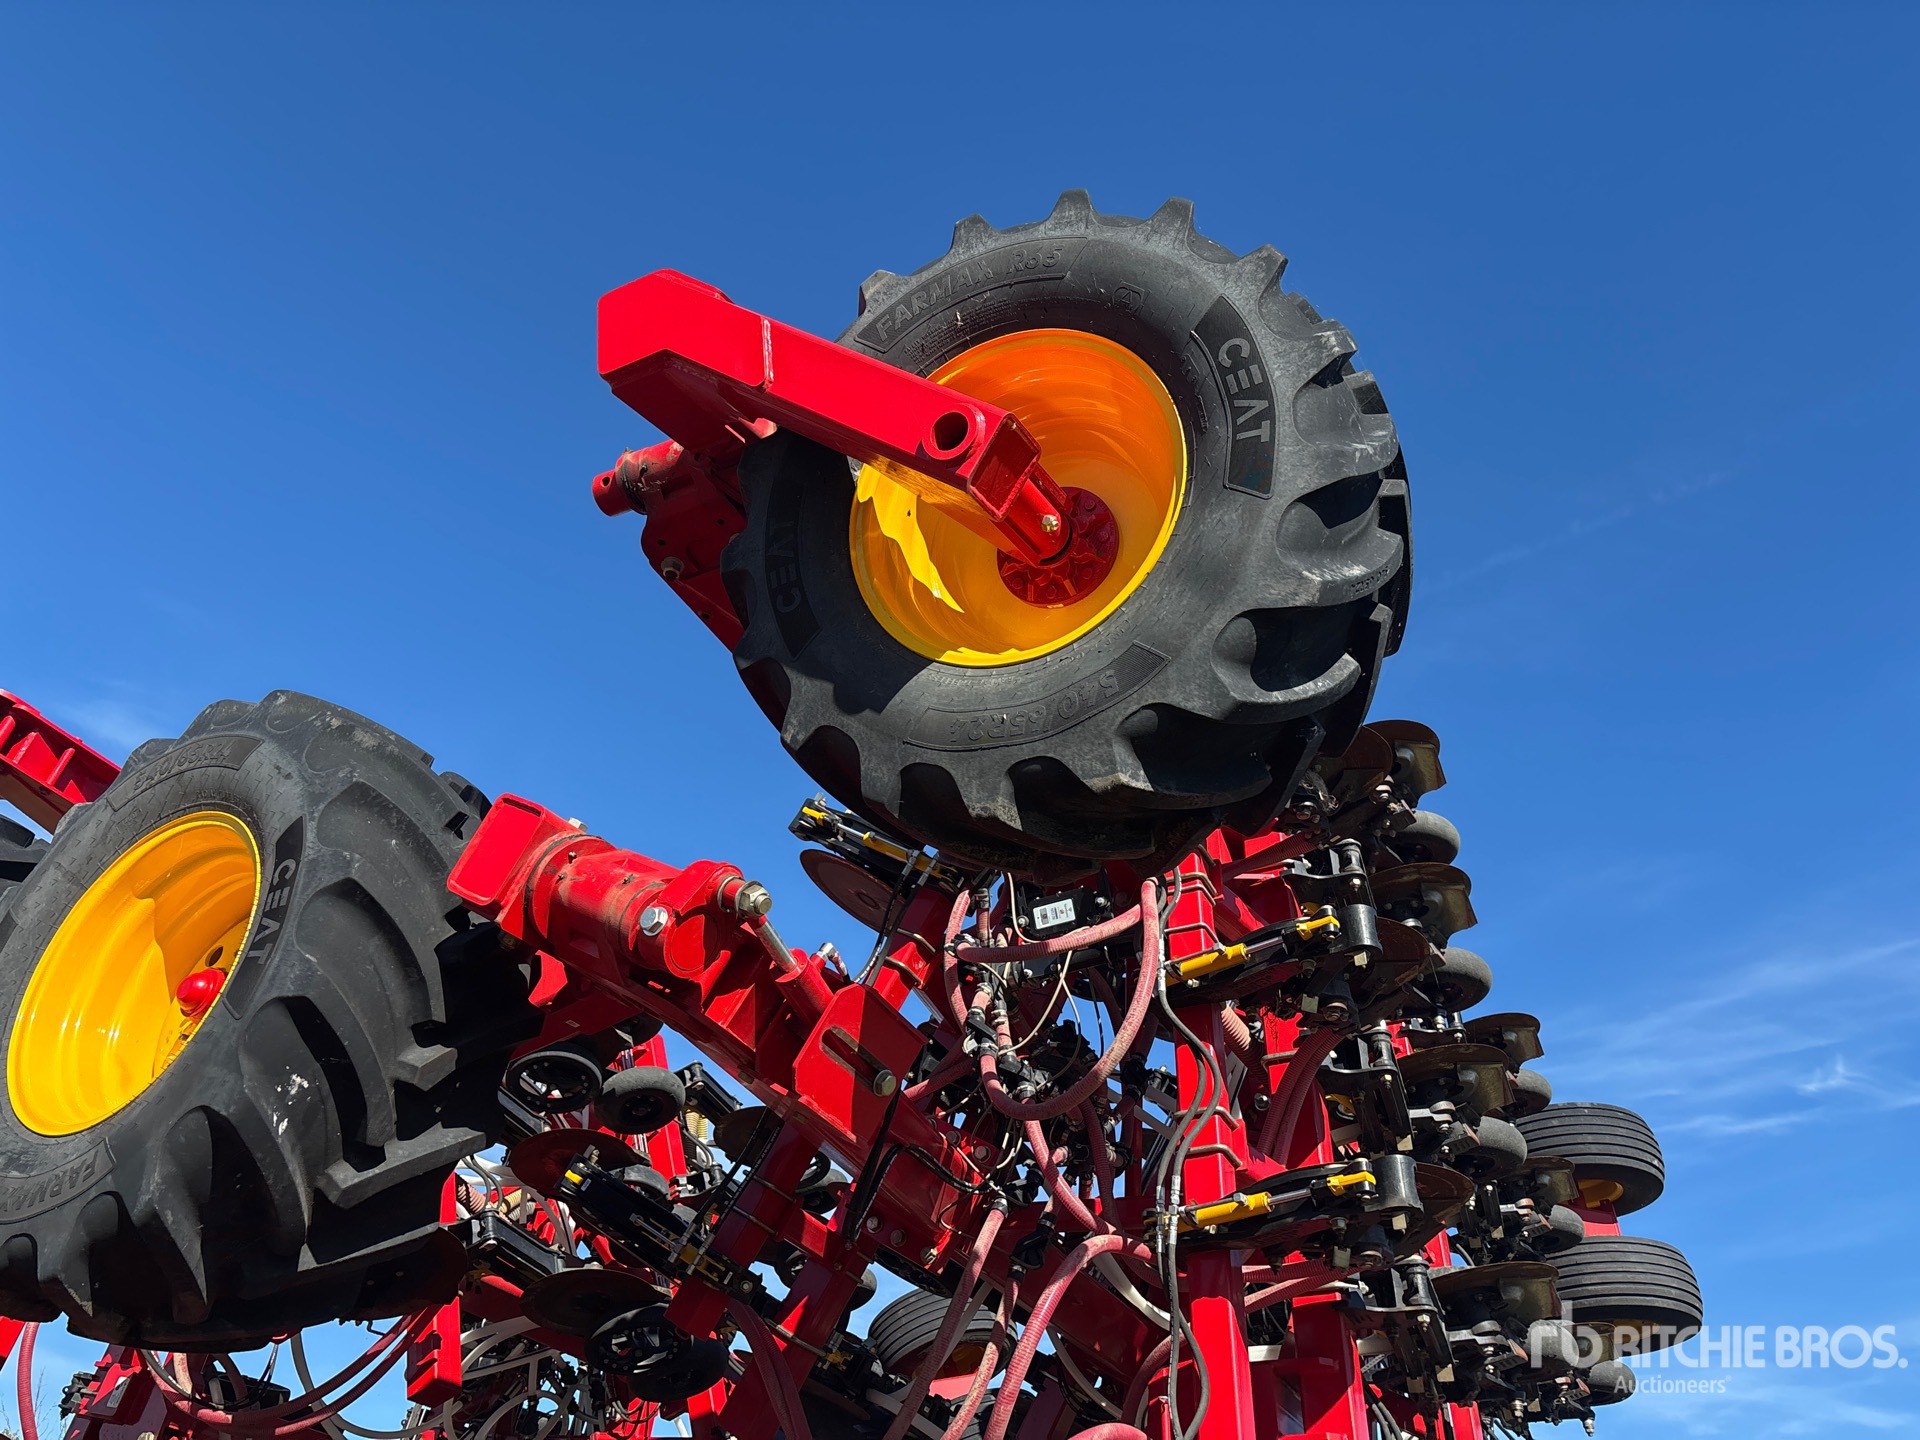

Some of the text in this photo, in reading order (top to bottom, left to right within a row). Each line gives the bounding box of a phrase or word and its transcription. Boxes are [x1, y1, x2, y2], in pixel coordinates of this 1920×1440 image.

[874, 259, 994, 342] FARMAX
[1005, 242, 1066, 276] R65
[1217, 337, 1271, 443] CEAT
[247, 858, 297, 965] CEAT
